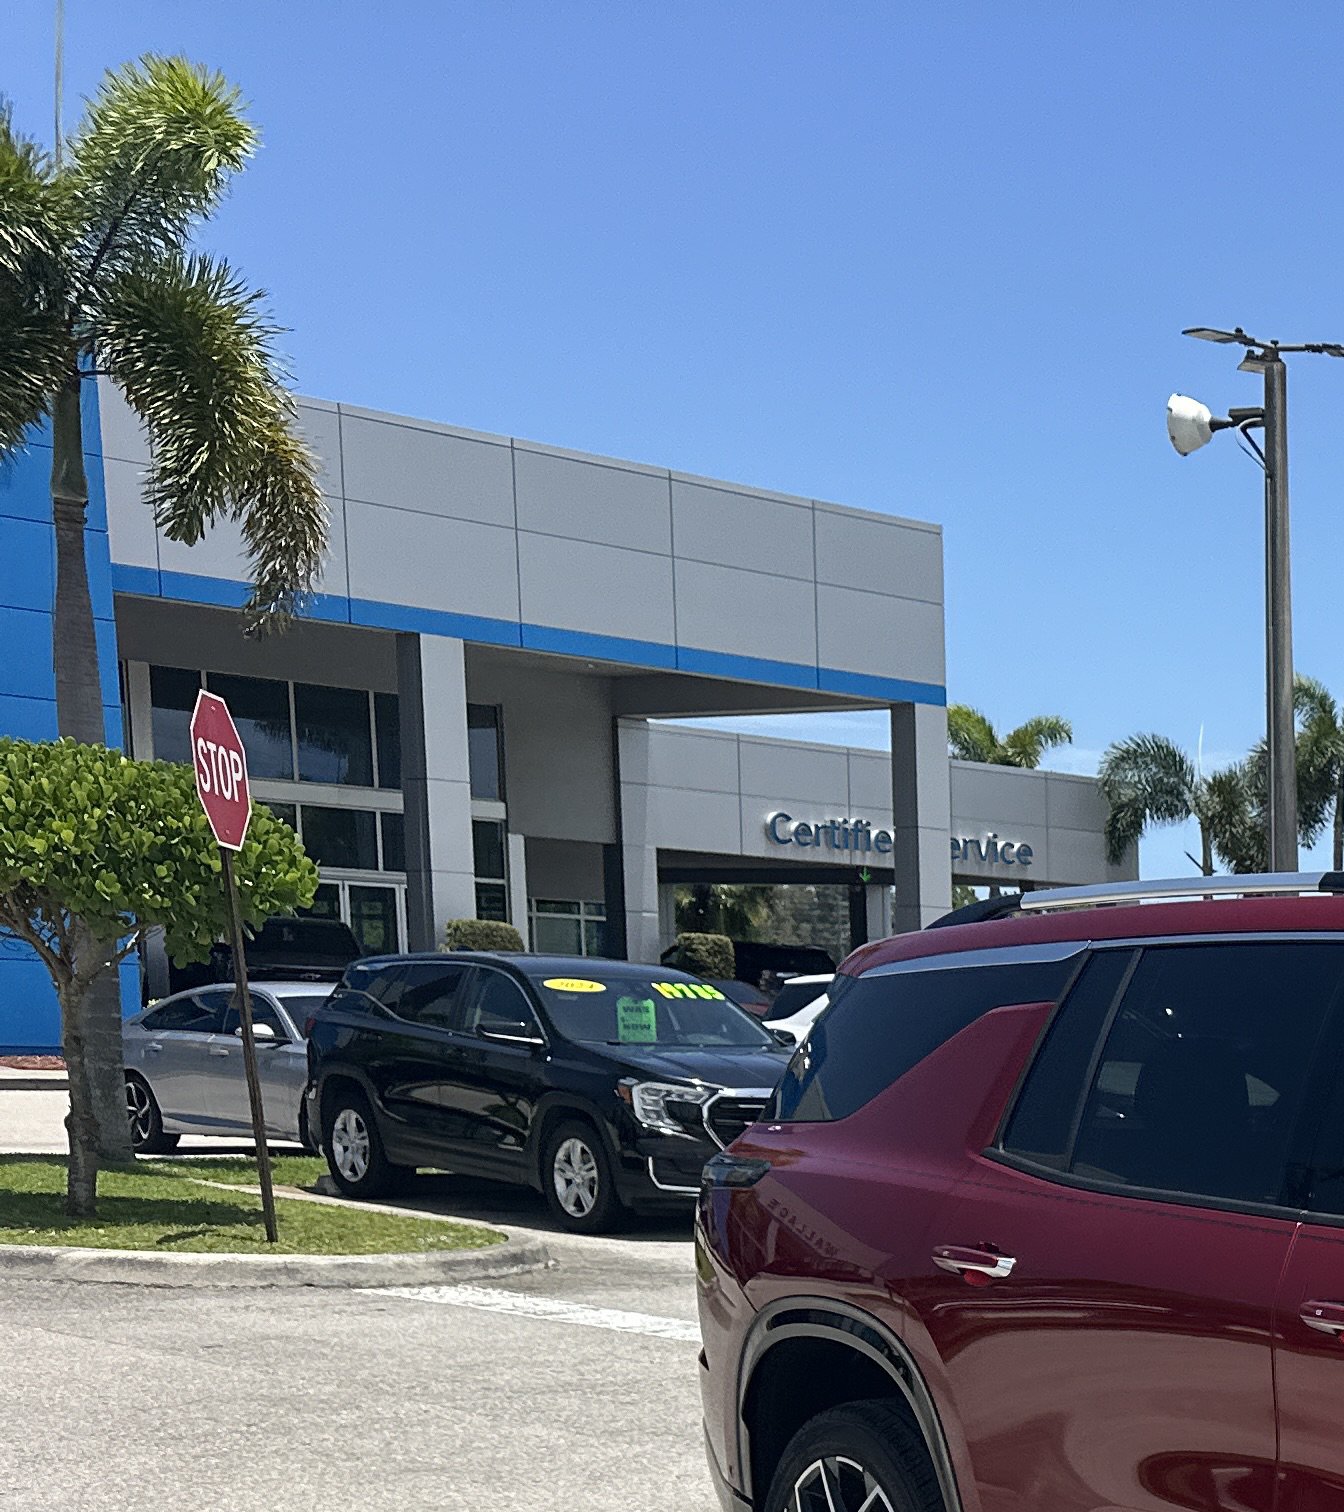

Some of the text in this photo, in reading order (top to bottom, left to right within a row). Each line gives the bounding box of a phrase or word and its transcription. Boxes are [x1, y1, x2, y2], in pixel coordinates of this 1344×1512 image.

[197, 737, 243, 802] STOP
[768, 811, 1033, 865] Certifie ervice
